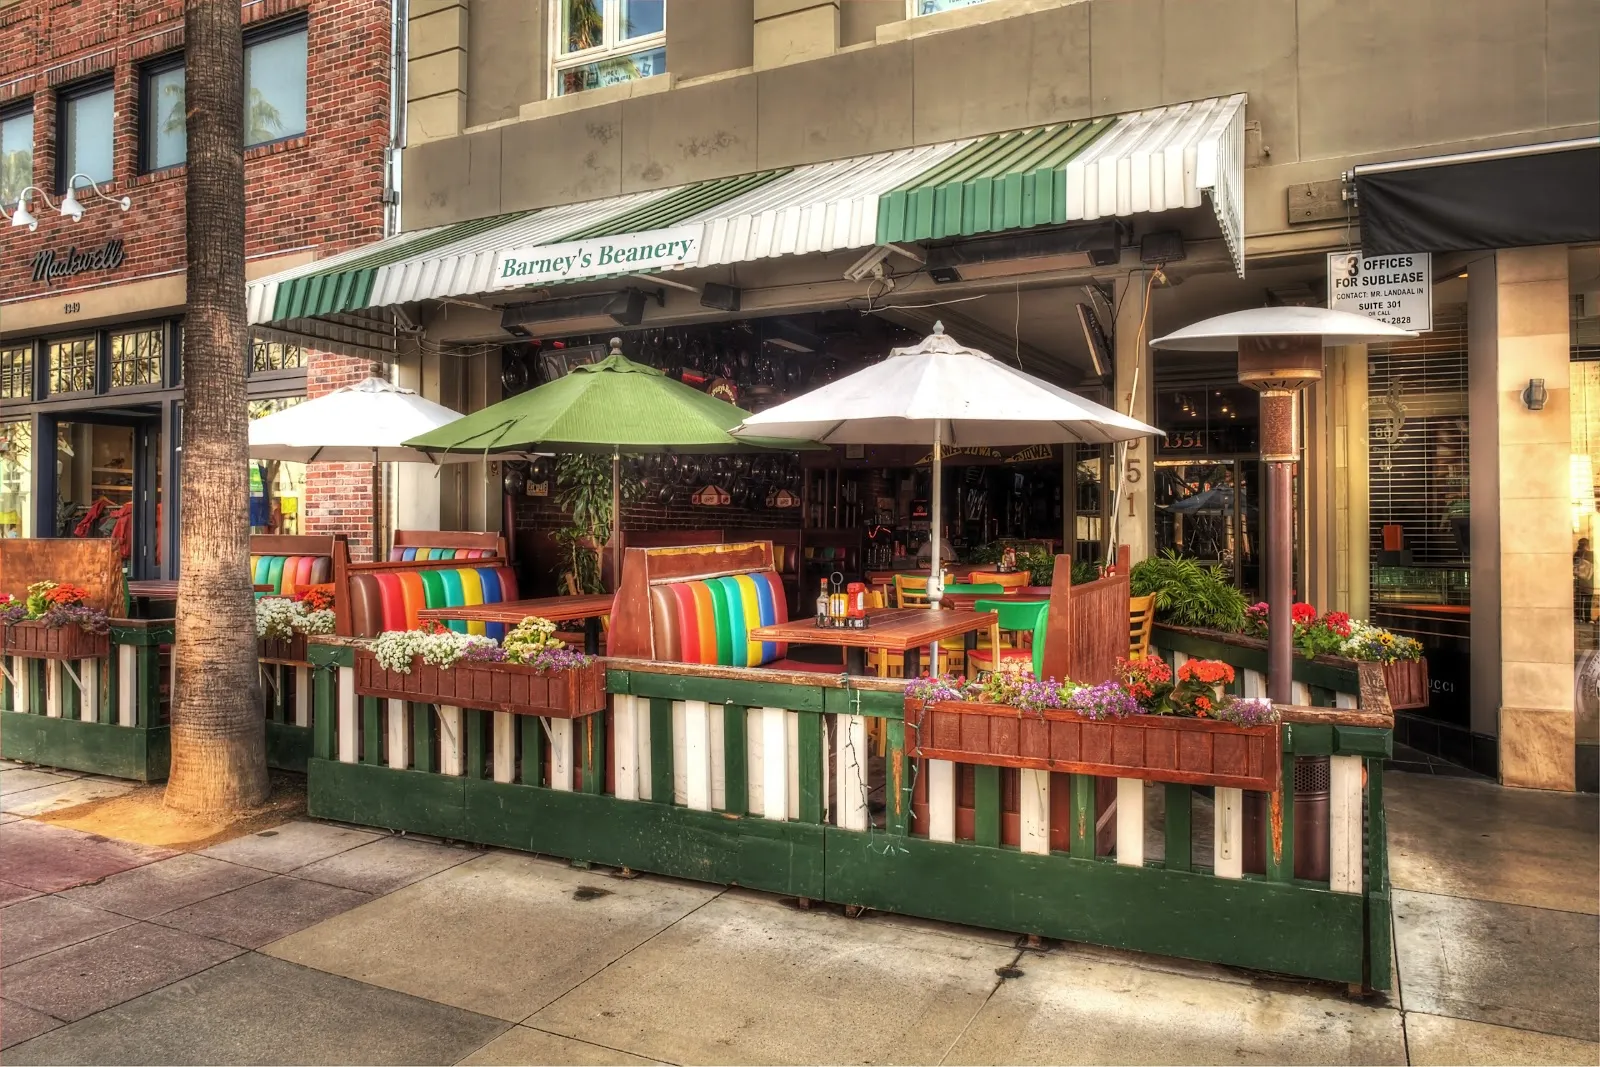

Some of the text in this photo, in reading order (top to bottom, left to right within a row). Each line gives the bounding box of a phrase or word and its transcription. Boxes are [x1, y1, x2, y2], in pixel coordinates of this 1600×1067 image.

[30, 239, 124, 287] Madewell
[501, 238, 695, 279] Barney's Beanery
[1347, 256, 1413, 277] 3 OFFICES
[1335, 271, 1424, 288] FOR SUBLEASE
[1336, 291, 1369, 300] CONTACT:
[1370, 290, 1383, 298] MR.
[64, 302, 81, 315] 1349
[1358, 300, 1401, 311] SUITE 301
[1162, 431, 1203, 448] 1351
